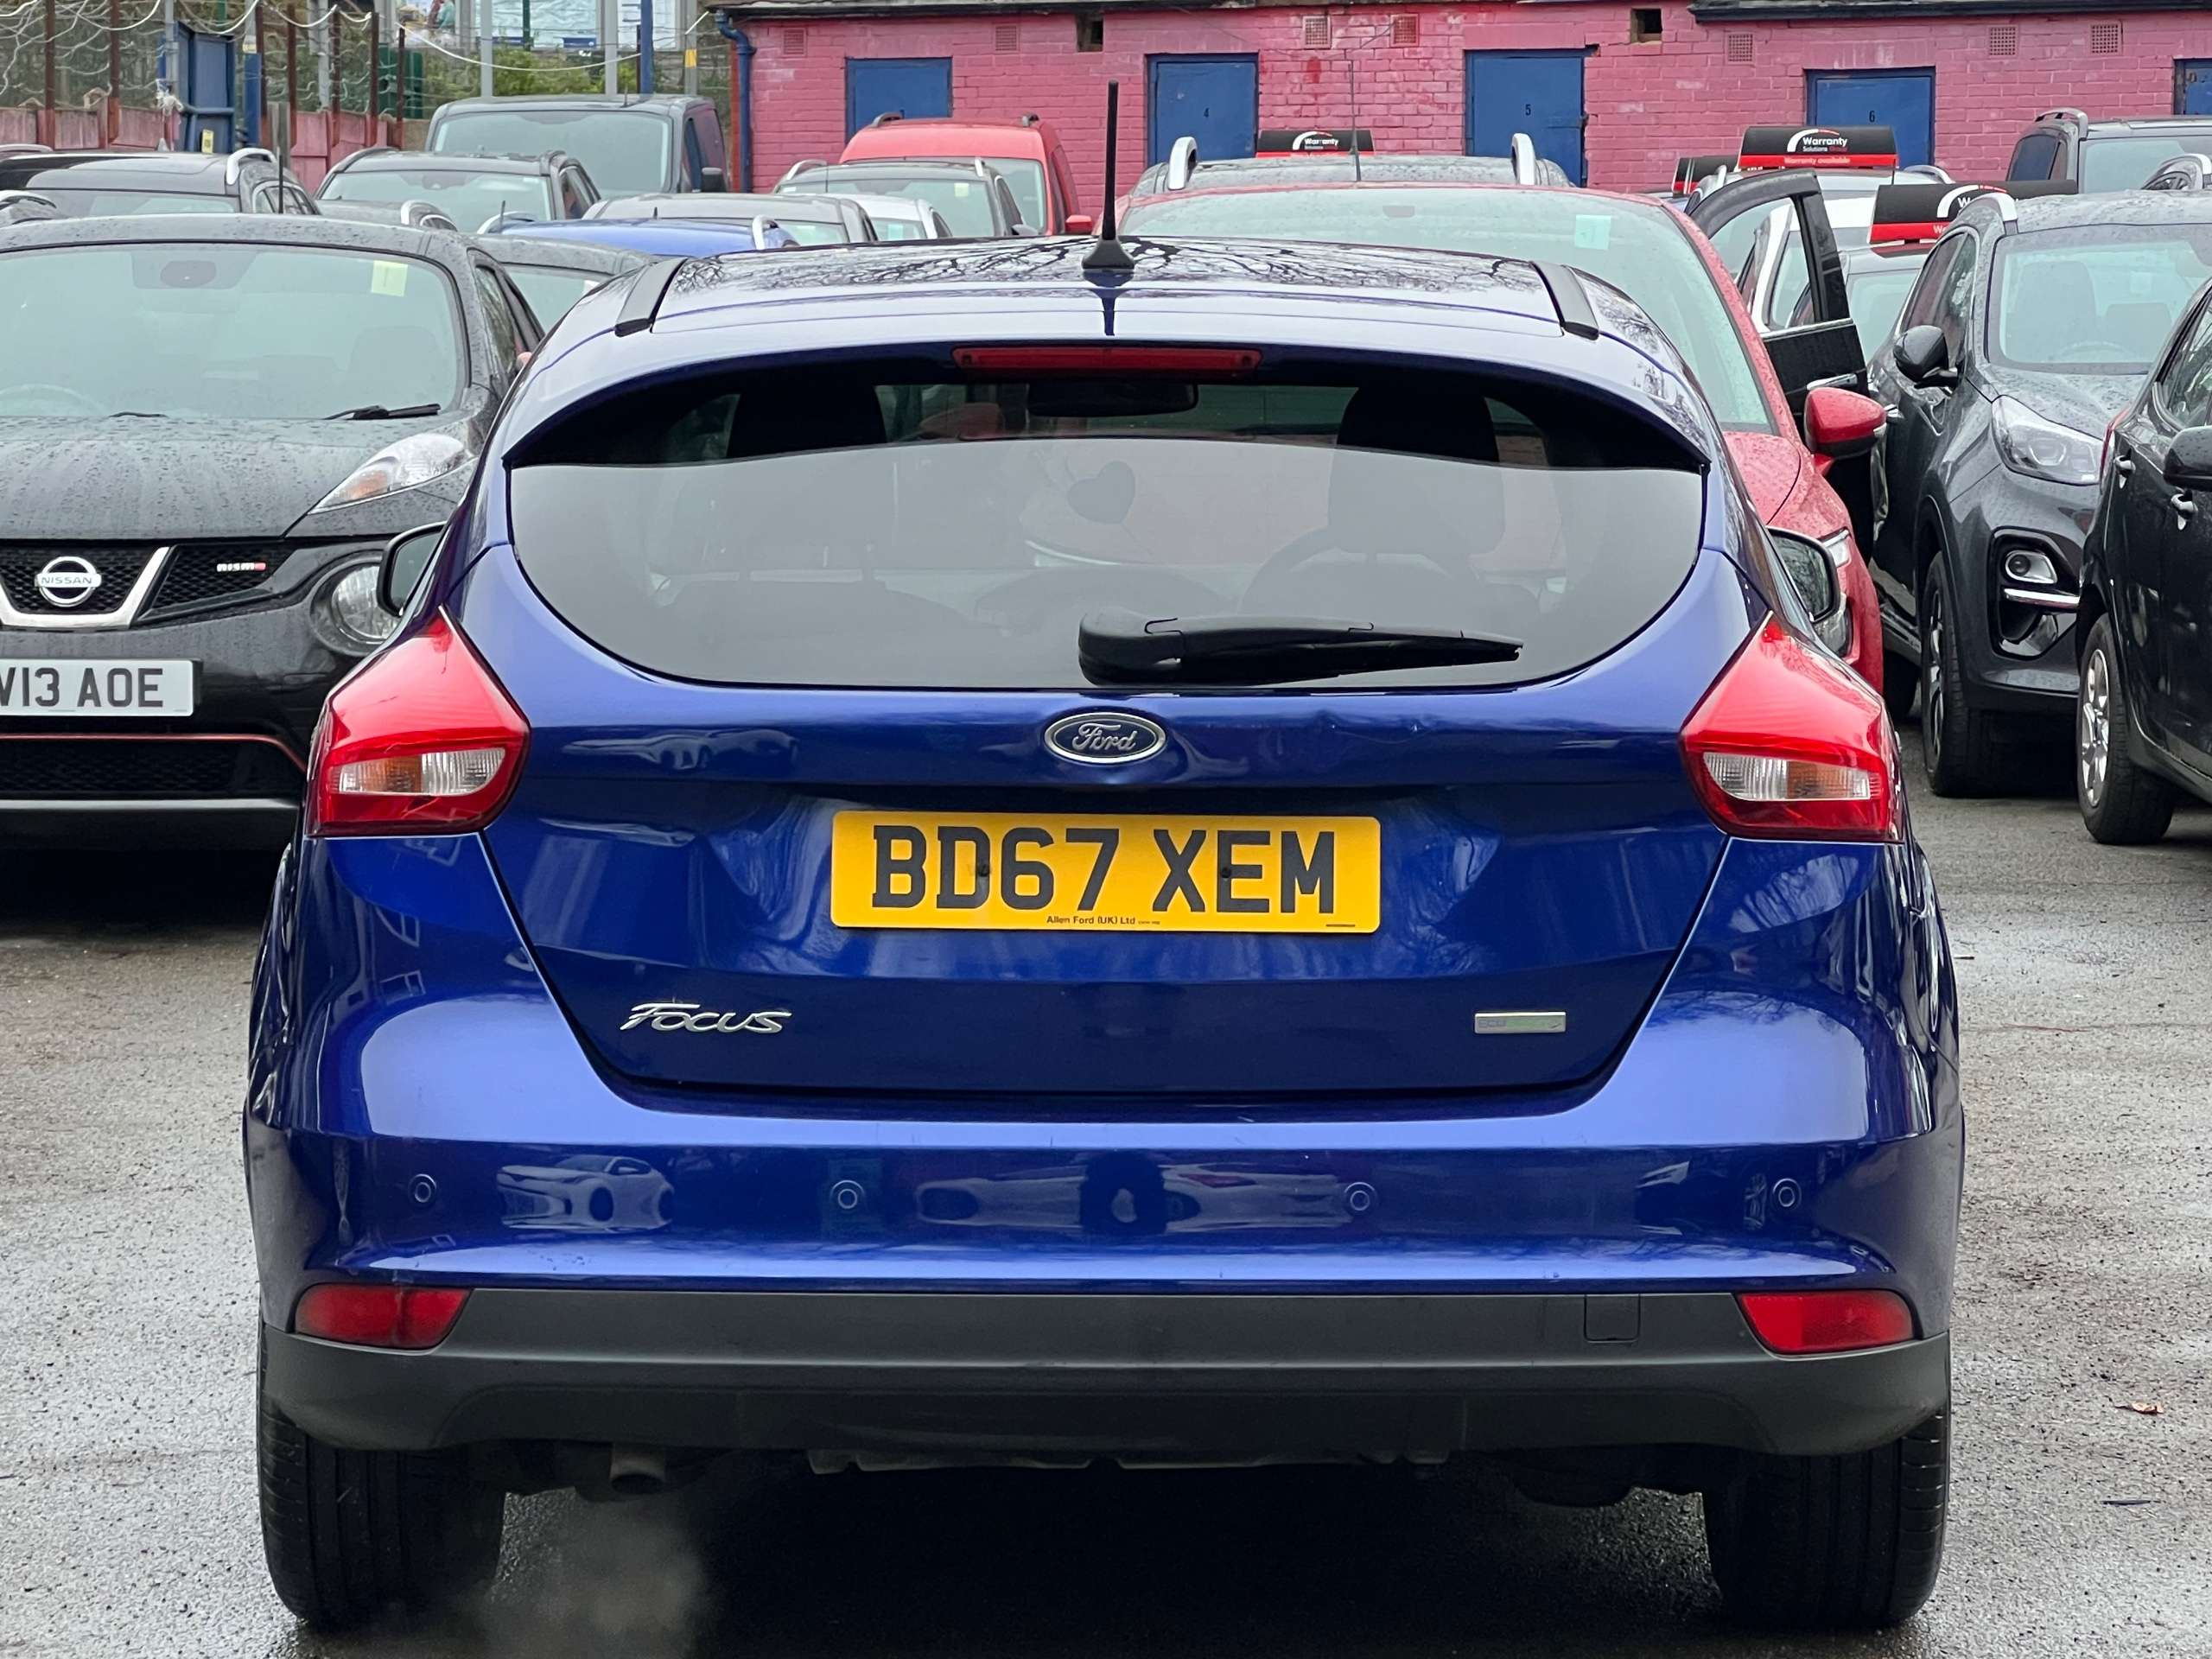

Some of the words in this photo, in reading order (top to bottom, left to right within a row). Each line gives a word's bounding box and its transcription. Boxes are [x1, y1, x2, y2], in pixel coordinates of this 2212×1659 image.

[1203, 107, 1210, 118] 4
[1525, 103, 1532, 116] 5
[1869, 110, 1876, 123] 6
[1802, 137, 1847, 148] Warranty
[1783, 156, 1816, 165] Warranty
[41, 576, 92, 585] NISSAN
[77, 667, 163, 708] AOE
[1071, 722, 1138, 751] Ford
[872, 824, 1120, 911] BD67
[1152, 829, 1335, 914] XEM
[1073, 916, 1094, 925] Ford
[1097, 916, 1118, 925] (UK)
